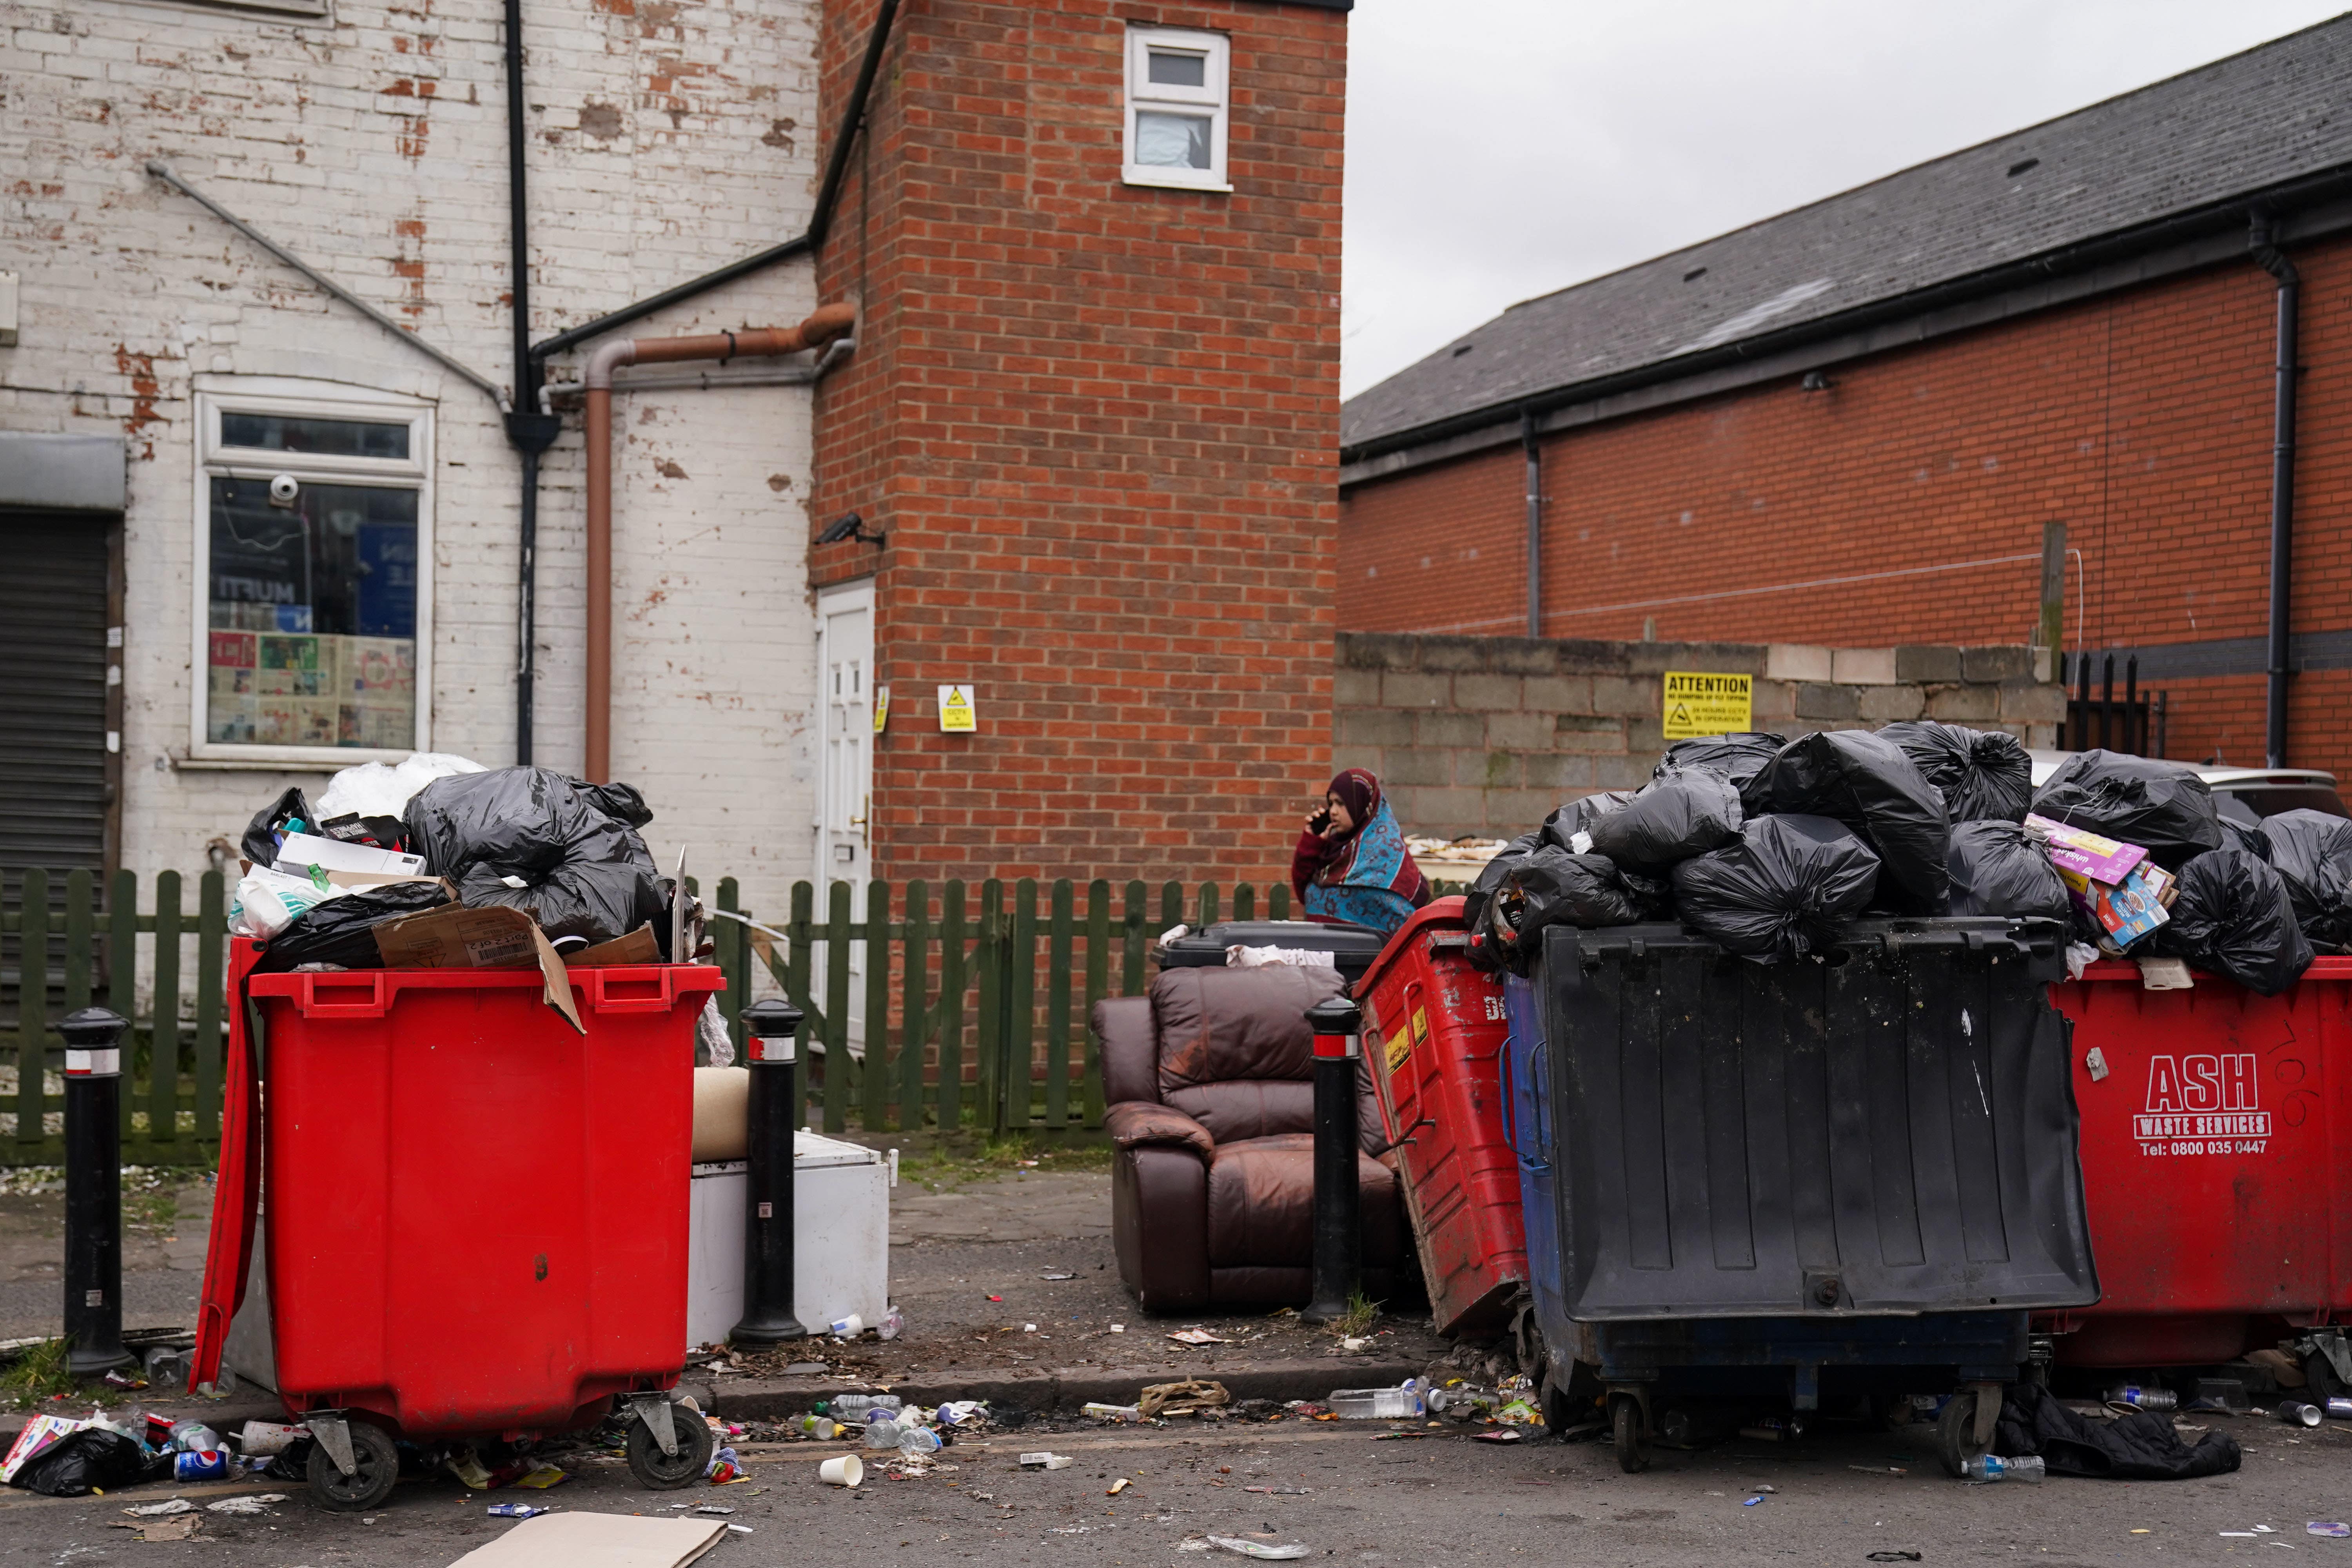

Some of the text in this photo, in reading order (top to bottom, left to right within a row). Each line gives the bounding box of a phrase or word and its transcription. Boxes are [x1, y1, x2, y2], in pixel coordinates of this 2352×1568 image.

[1669, 676, 1748, 693] ATTENTION
[330, 822, 363, 835] HAPPINESS
[350, 828, 368, 836] UNBOX
[505, 934, 528, 943] Part
[2145, 1053, 2258, 1112] ASH
[2140, 1115, 2265, 1136] WASTE SERVICES
[2140, 1140, 2267, 1156] Tel: 0800 035 0447
